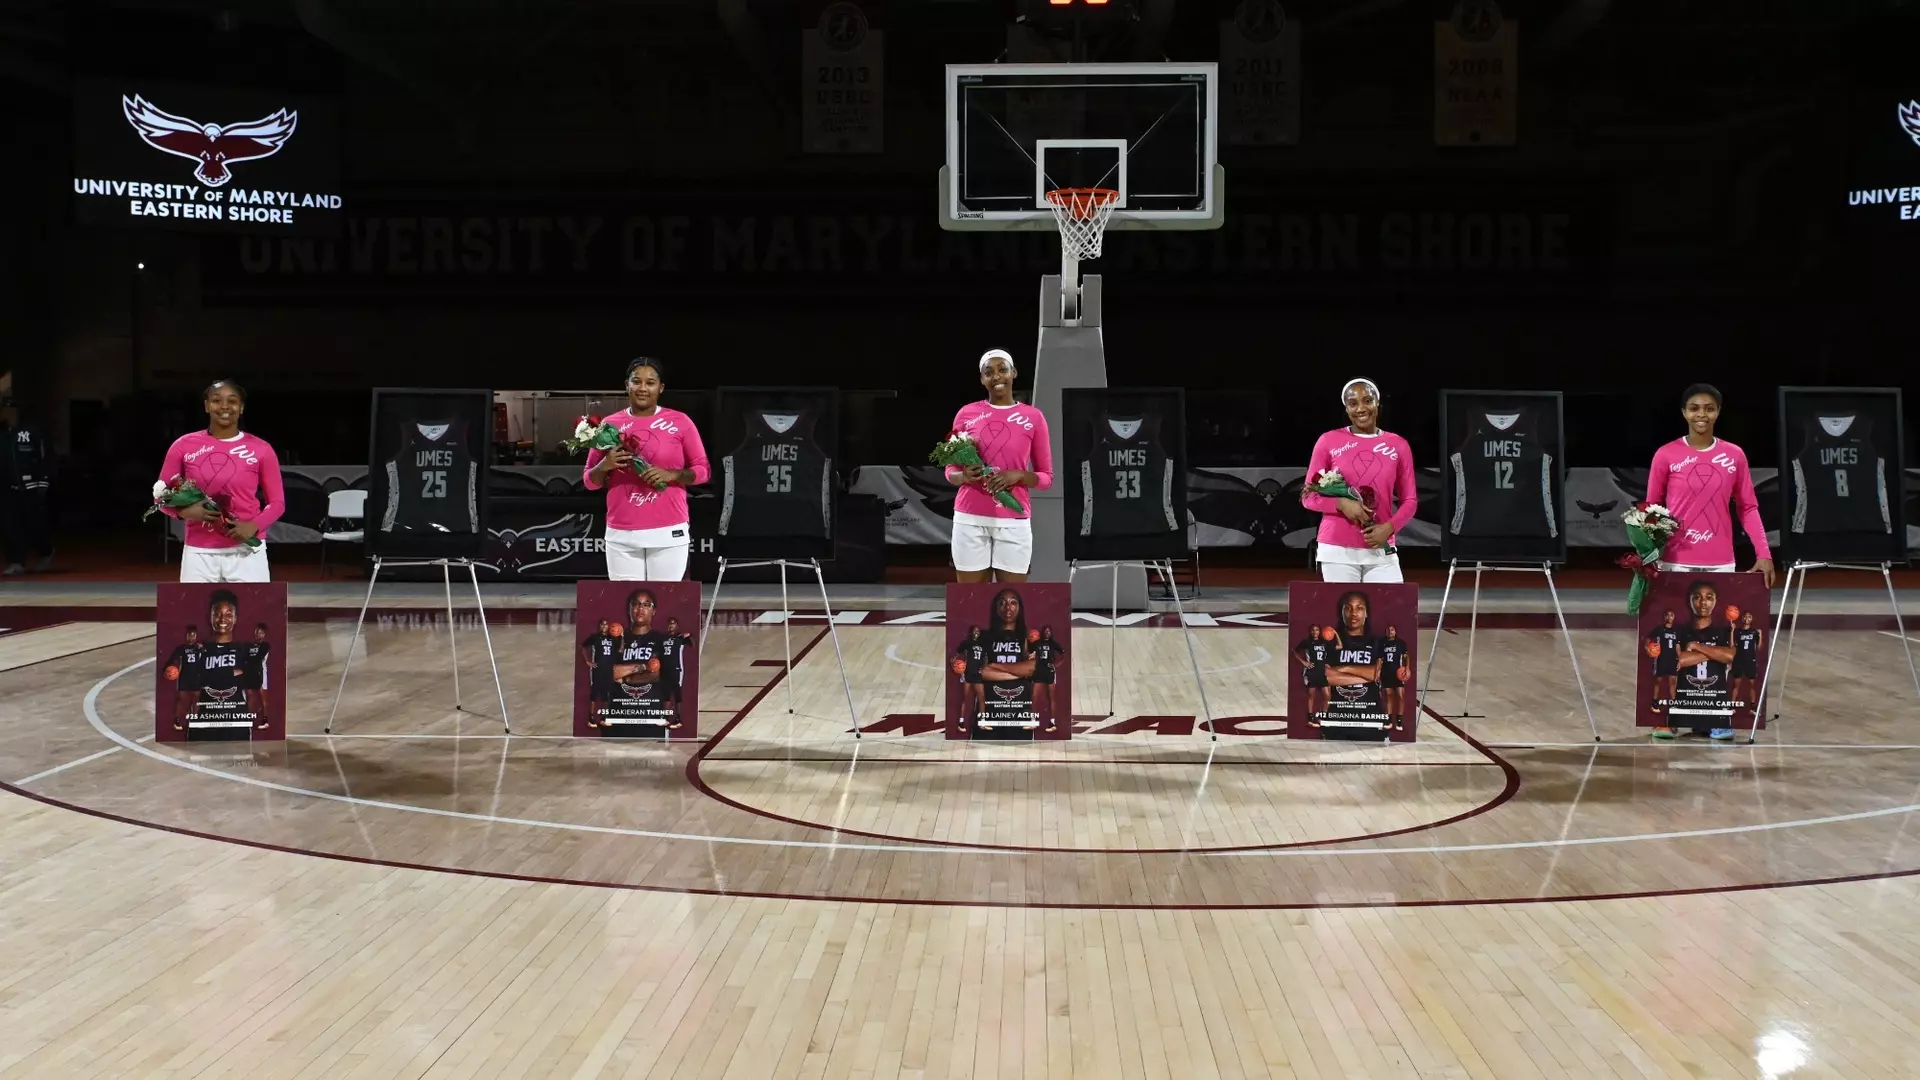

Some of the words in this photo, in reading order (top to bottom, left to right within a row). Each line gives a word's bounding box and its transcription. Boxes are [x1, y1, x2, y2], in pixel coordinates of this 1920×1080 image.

[817, 66, 870, 84] 2013
[74, 178, 199, 200] UNIVERSITY
[204, 190, 224, 202] OF
[228, 188, 342, 210] MARYLAND
[130, 200, 222, 220] EASTERN
[228, 206, 294, 224] SHORE
[239, 216, 604, 274] UNIVERSITY
[623, 216, 690, 273] OF
[1380, 212, 1572, 271] SHORE
[650, 418, 678, 434] We
[964, 411, 992, 429] Together
[1006, 412, 1034, 430] We
[184, 444, 215, 462] Together
[229, 444, 258, 465] We
[762, 444, 798, 462] UMES
[1108, 449, 1146, 467] UMES
[1329, 441, 1358, 458] Together
[1372, 442, 1399, 460] We
[1484, 440, 1522, 458] UMES
[1820, 448, 1858, 466] UMES
[416, 450, 453, 468] UMES
[1669, 456, 1698, 472] Together
[1712, 452, 1736, 474] We
[422, 470, 448, 498] 25
[766, 465, 792, 492] 35
[1115, 470, 1141, 498] 33
[1494, 460, 1514, 490] 12
[1834, 468, 1850, 497] 8
[628, 492, 658, 506] Fight
[536, 538, 606, 552] EASTER
[1684, 528, 1714, 544] Fight
[623, 647, 652, 661] UMES
[993, 642, 1021, 652] UMES
[187, 654, 195, 662] 25
[205, 654, 236, 669] UMES
[1340, 650, 1372, 664] UMES
